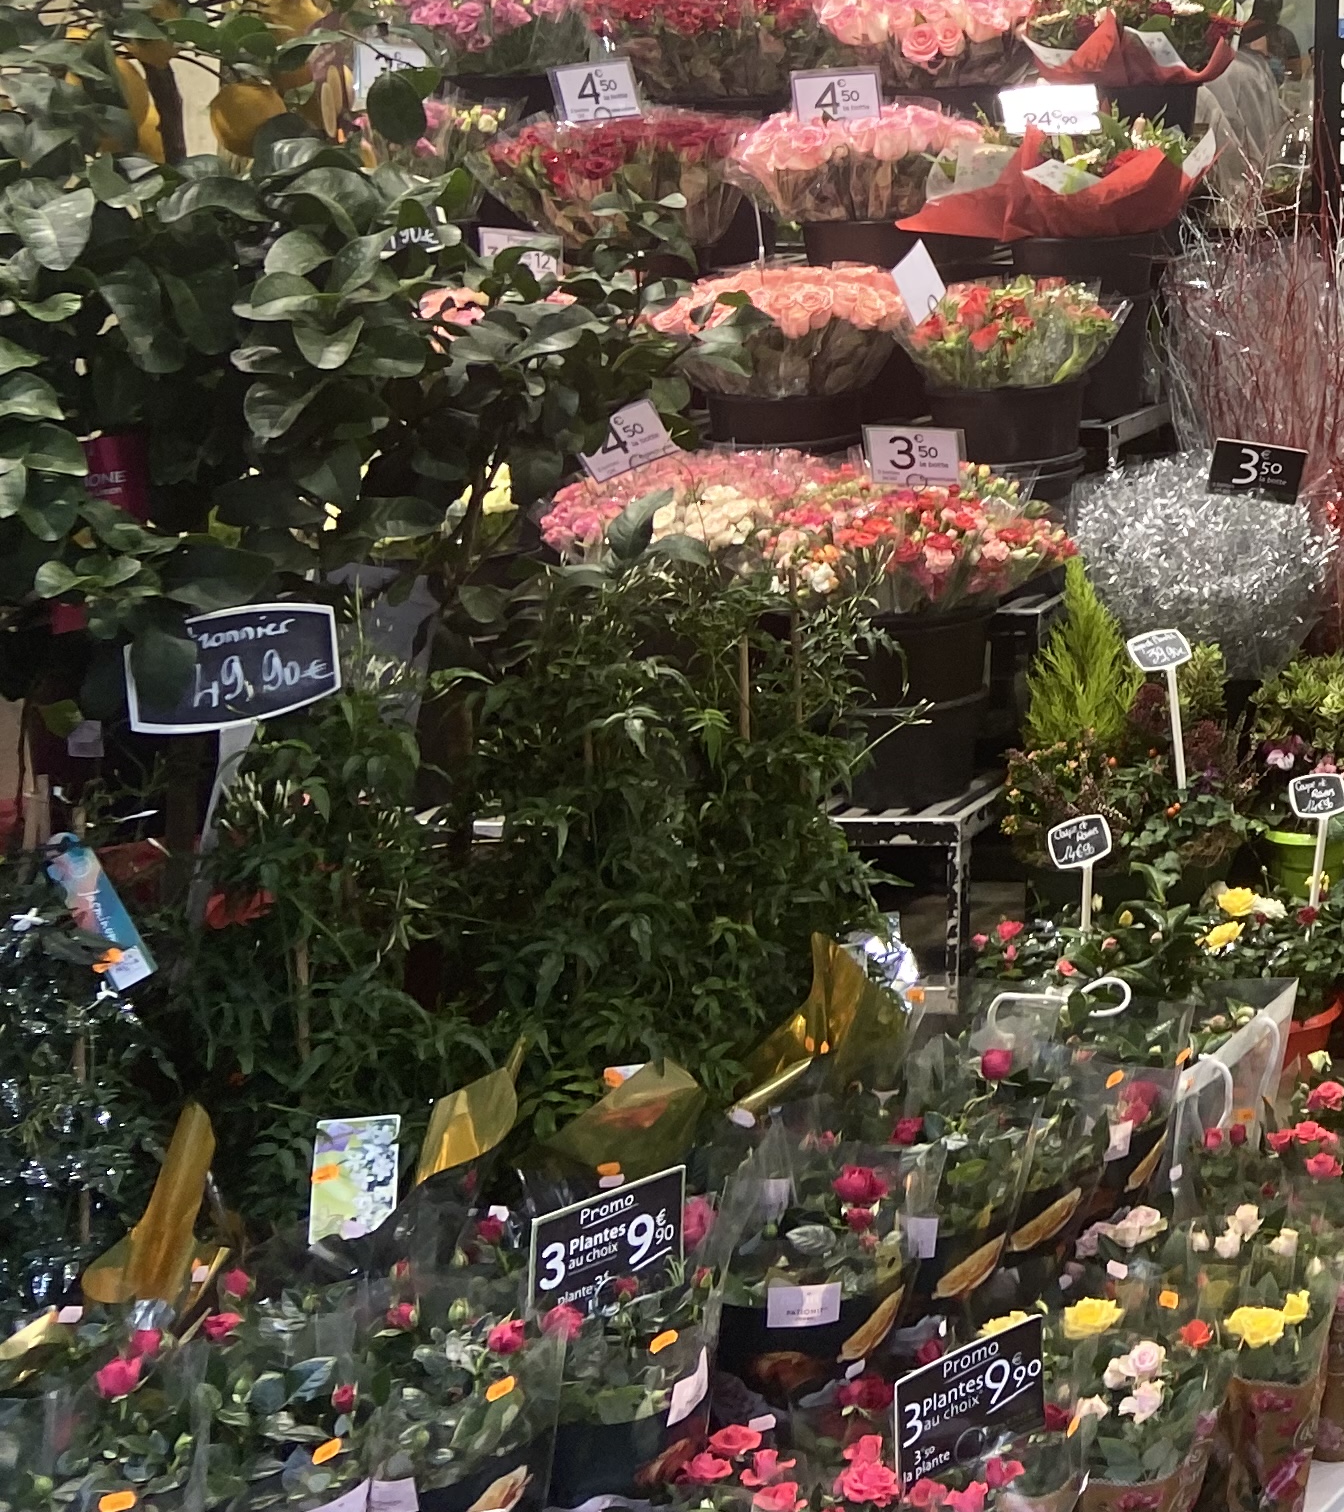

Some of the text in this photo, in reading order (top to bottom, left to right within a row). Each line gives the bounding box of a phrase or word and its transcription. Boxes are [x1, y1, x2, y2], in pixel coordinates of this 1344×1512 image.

[580, 1194, 635, 1225] Promo
[539, 1242, 566, 1291] 3
[569, 1223, 627, 1256] Plantes
[568, 1241, 619, 1270] au choix
[943, 1341, 999, 1379] Promo
[902, 1402, 924, 1449] 3
[922, 1374, 984, 1417] Plantes
[923, 1415, 940, 1432] au
[903, 1450, 951, 1484] la plante
